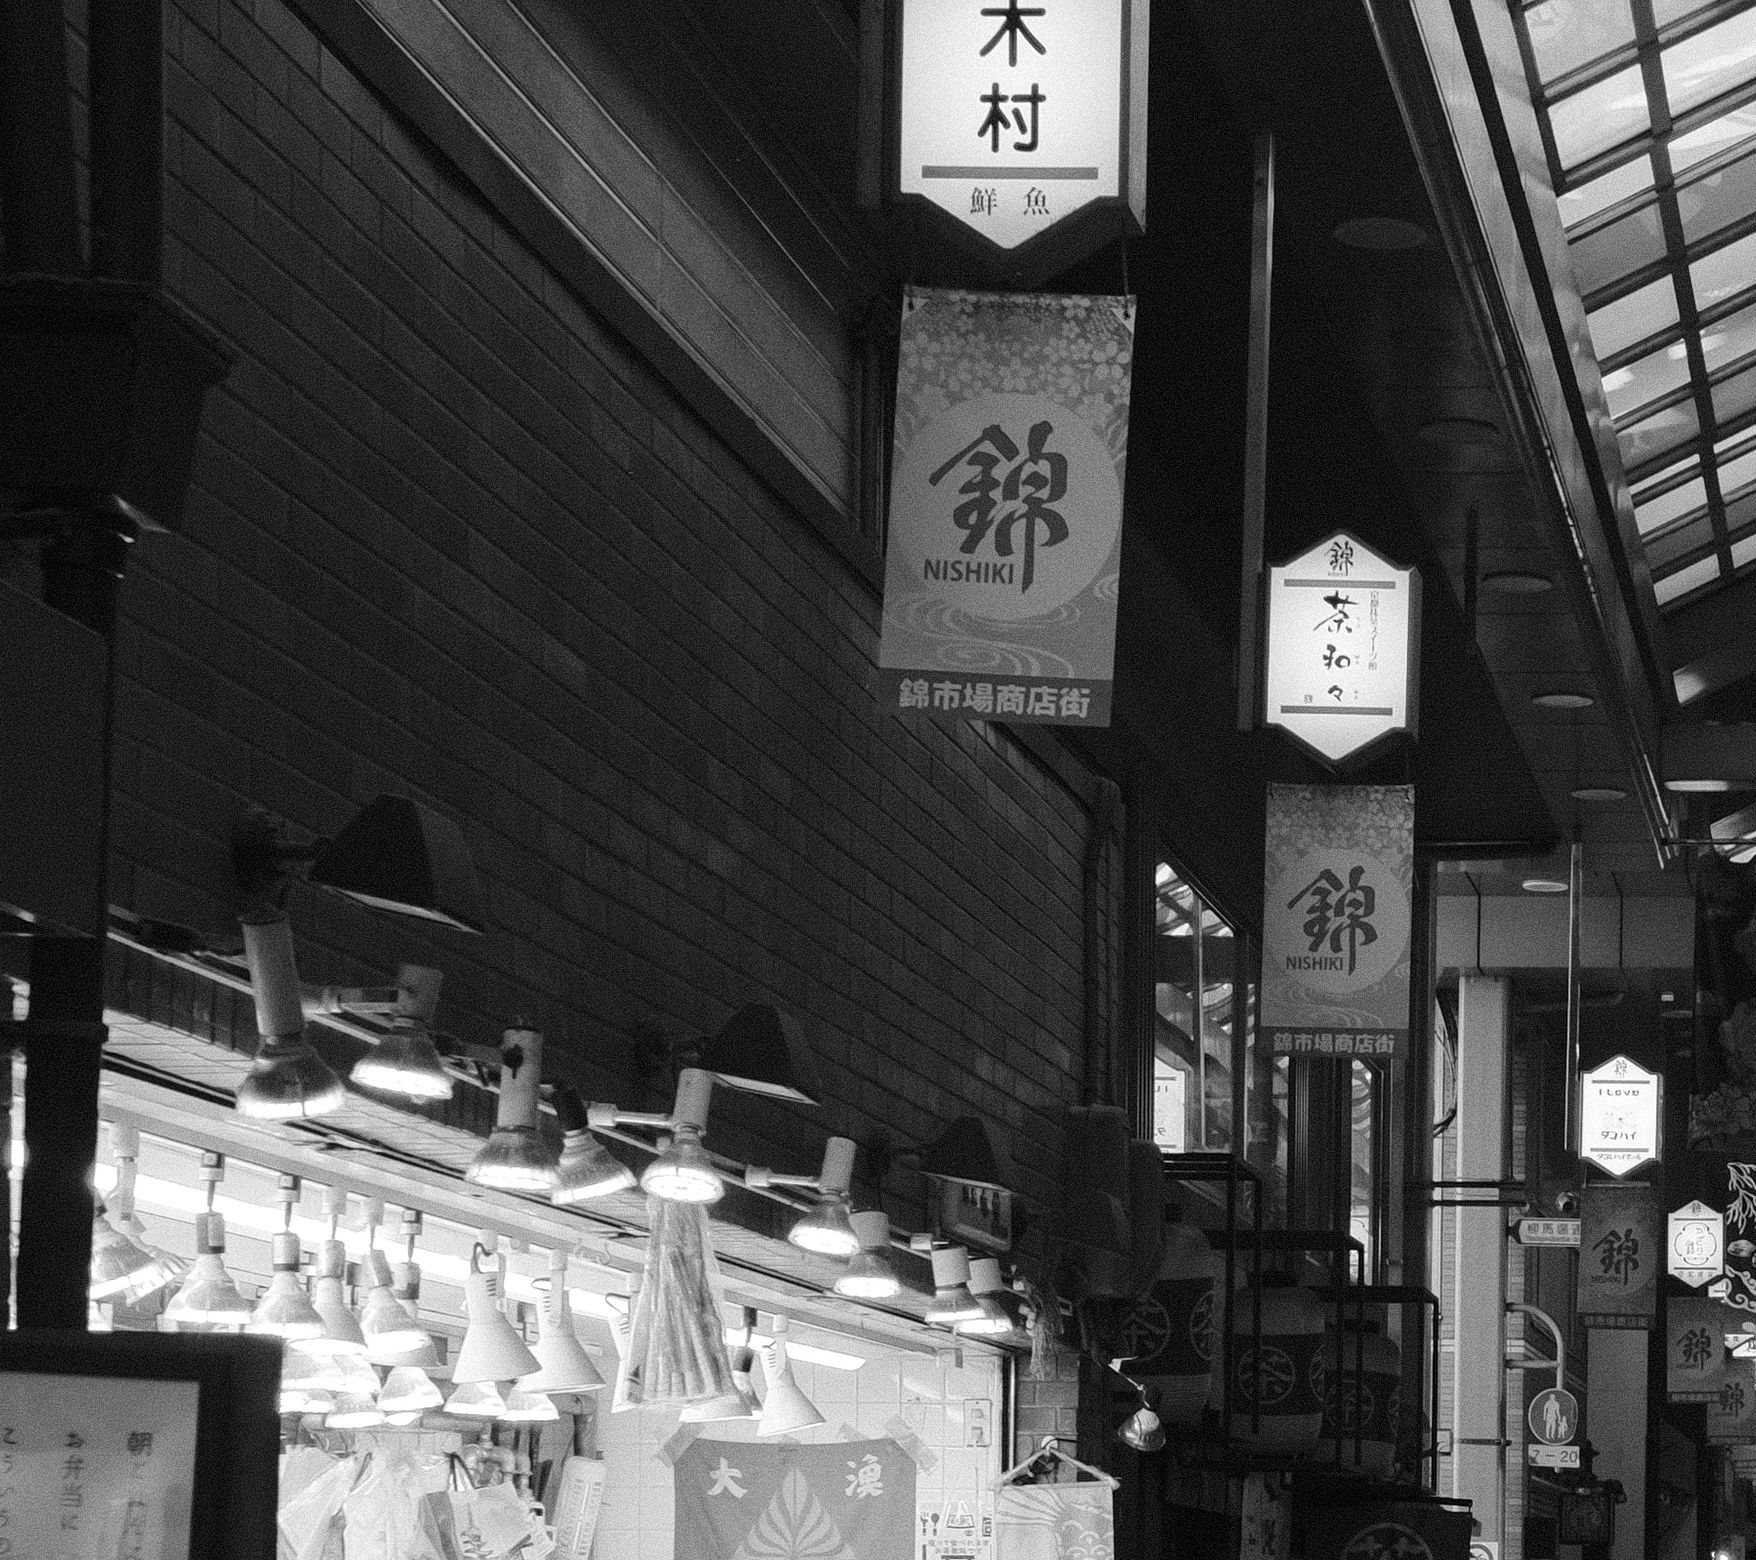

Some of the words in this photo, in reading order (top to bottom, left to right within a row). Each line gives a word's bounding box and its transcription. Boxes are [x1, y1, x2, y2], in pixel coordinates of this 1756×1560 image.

[928, 420, 1070, 595] 錦
[923, 558, 1015, 586] NISHIKI
[899, 678, 1091, 719] 錦市場商店街
[1286, 865, 1379, 977] 錦
[1286, 956, 1344, 971] NISHIKI
[1273, 1033, 1396, 1054] 錦市場商店街
[1593, 1228, 1640, 1286] 錦
